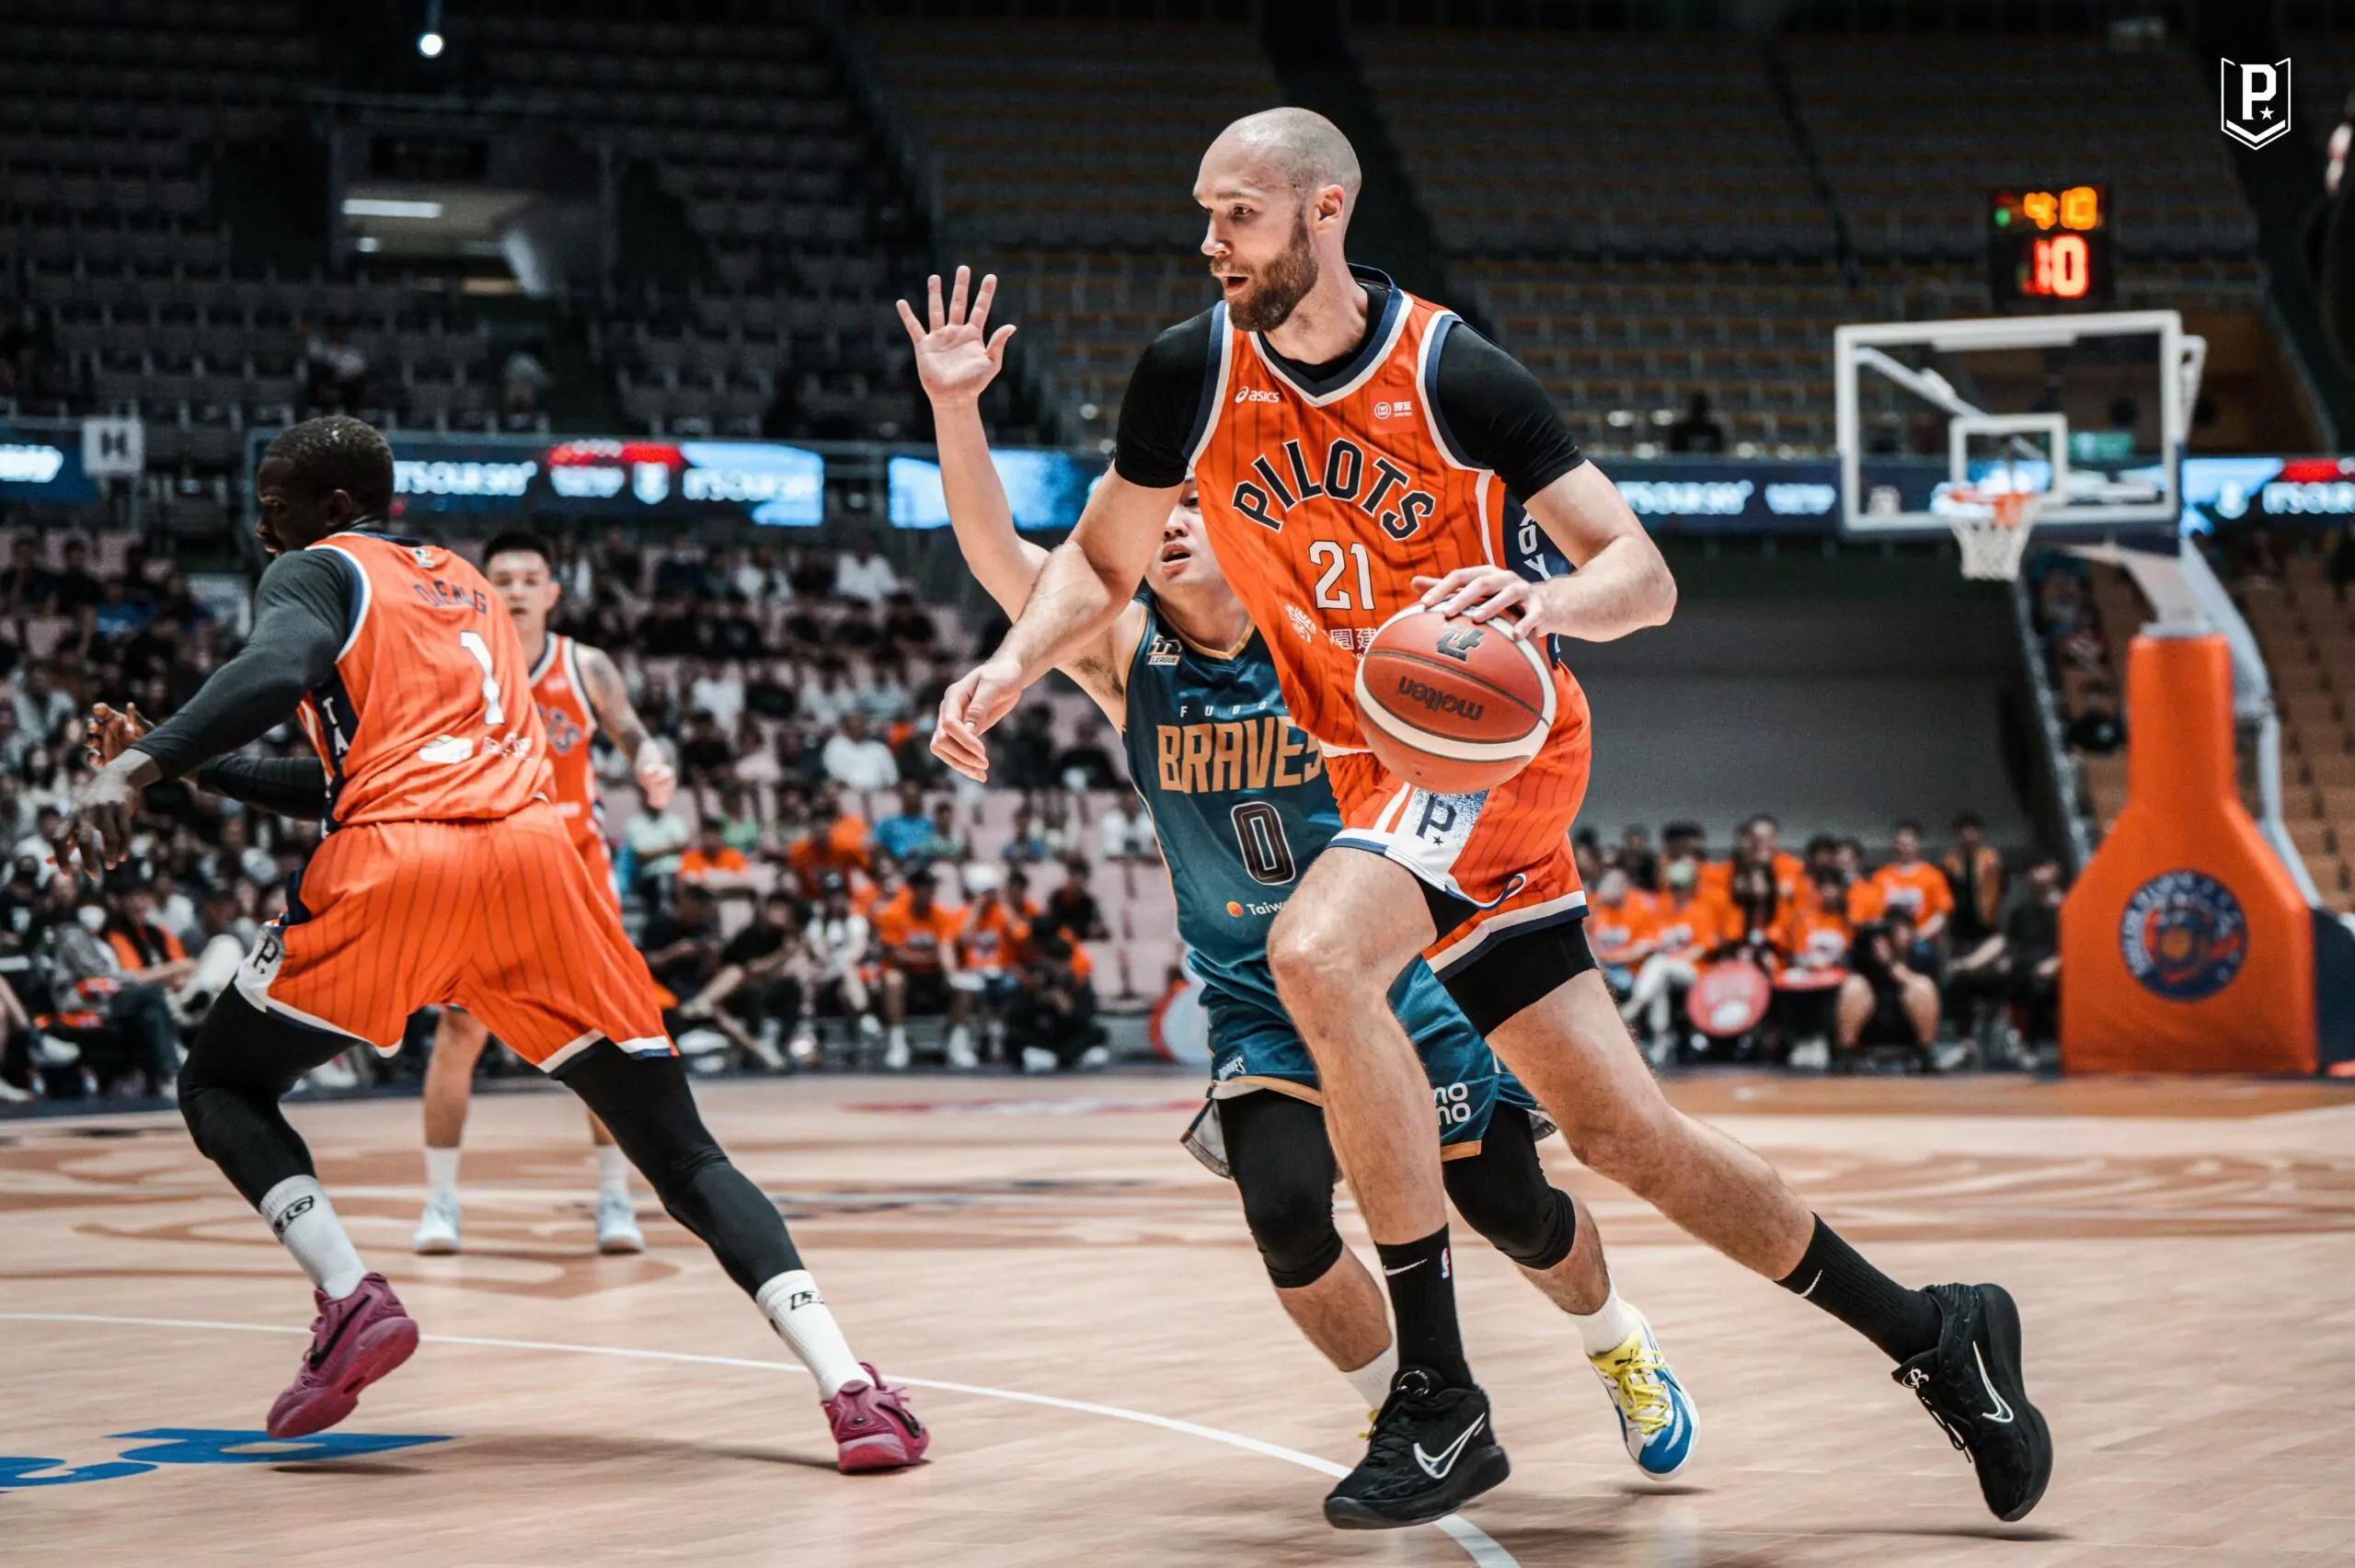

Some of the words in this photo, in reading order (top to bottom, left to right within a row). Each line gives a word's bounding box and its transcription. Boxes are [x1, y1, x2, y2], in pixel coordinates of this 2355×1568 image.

[1248, 390, 1281, 403] asics
[1232, 438, 1437, 541] PILOTS
[1308, 540, 1376, 611] 21
[461, 632, 505, 725] 1
[1180, 701, 1288, 717] FUBO
[1398, 676, 1484, 720] molten
[1156, 715, 1323, 795] BRAVES
[1230, 801, 1296, 886] 0
[1416, 792, 1457, 839] P
